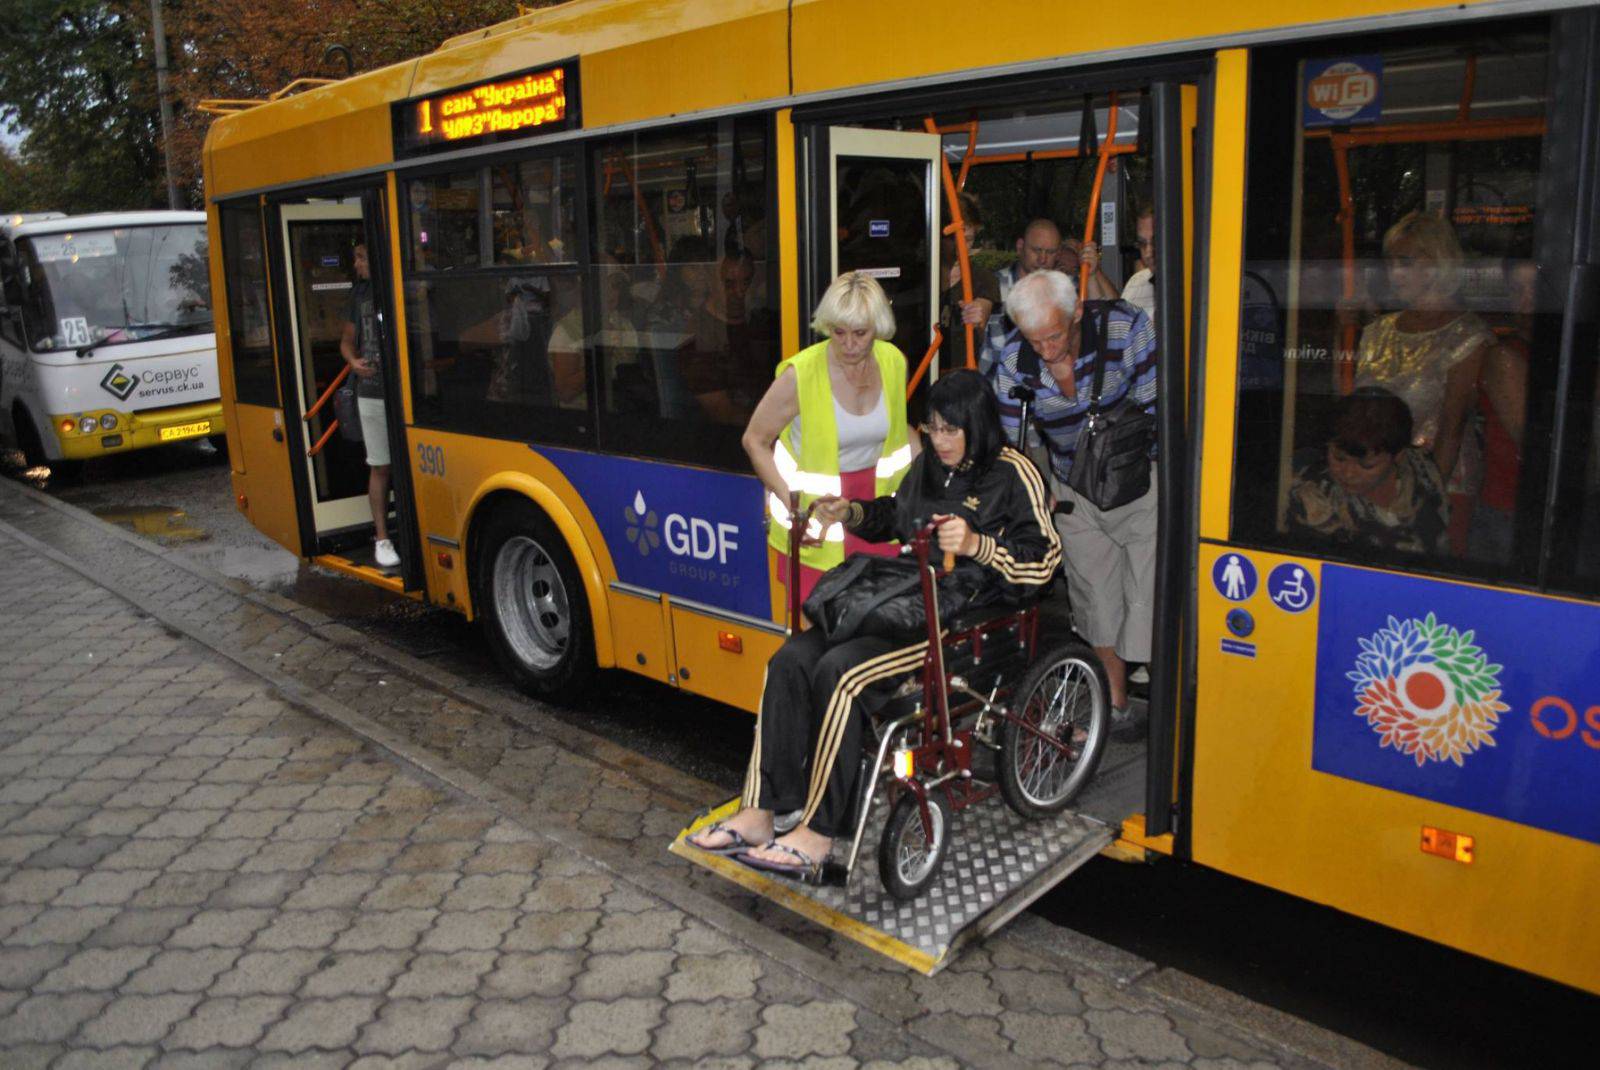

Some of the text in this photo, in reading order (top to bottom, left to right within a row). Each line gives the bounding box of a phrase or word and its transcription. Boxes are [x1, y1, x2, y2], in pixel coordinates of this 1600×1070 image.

[419, 101, 432, 133] 1
[64, 319, 87, 347] 25
[139, 382, 204, 398] servus.ck.ua
[142, 367, 199, 385] Сервус
[417, 443, 446, 476] 390
[665, 513, 739, 564] GDF
